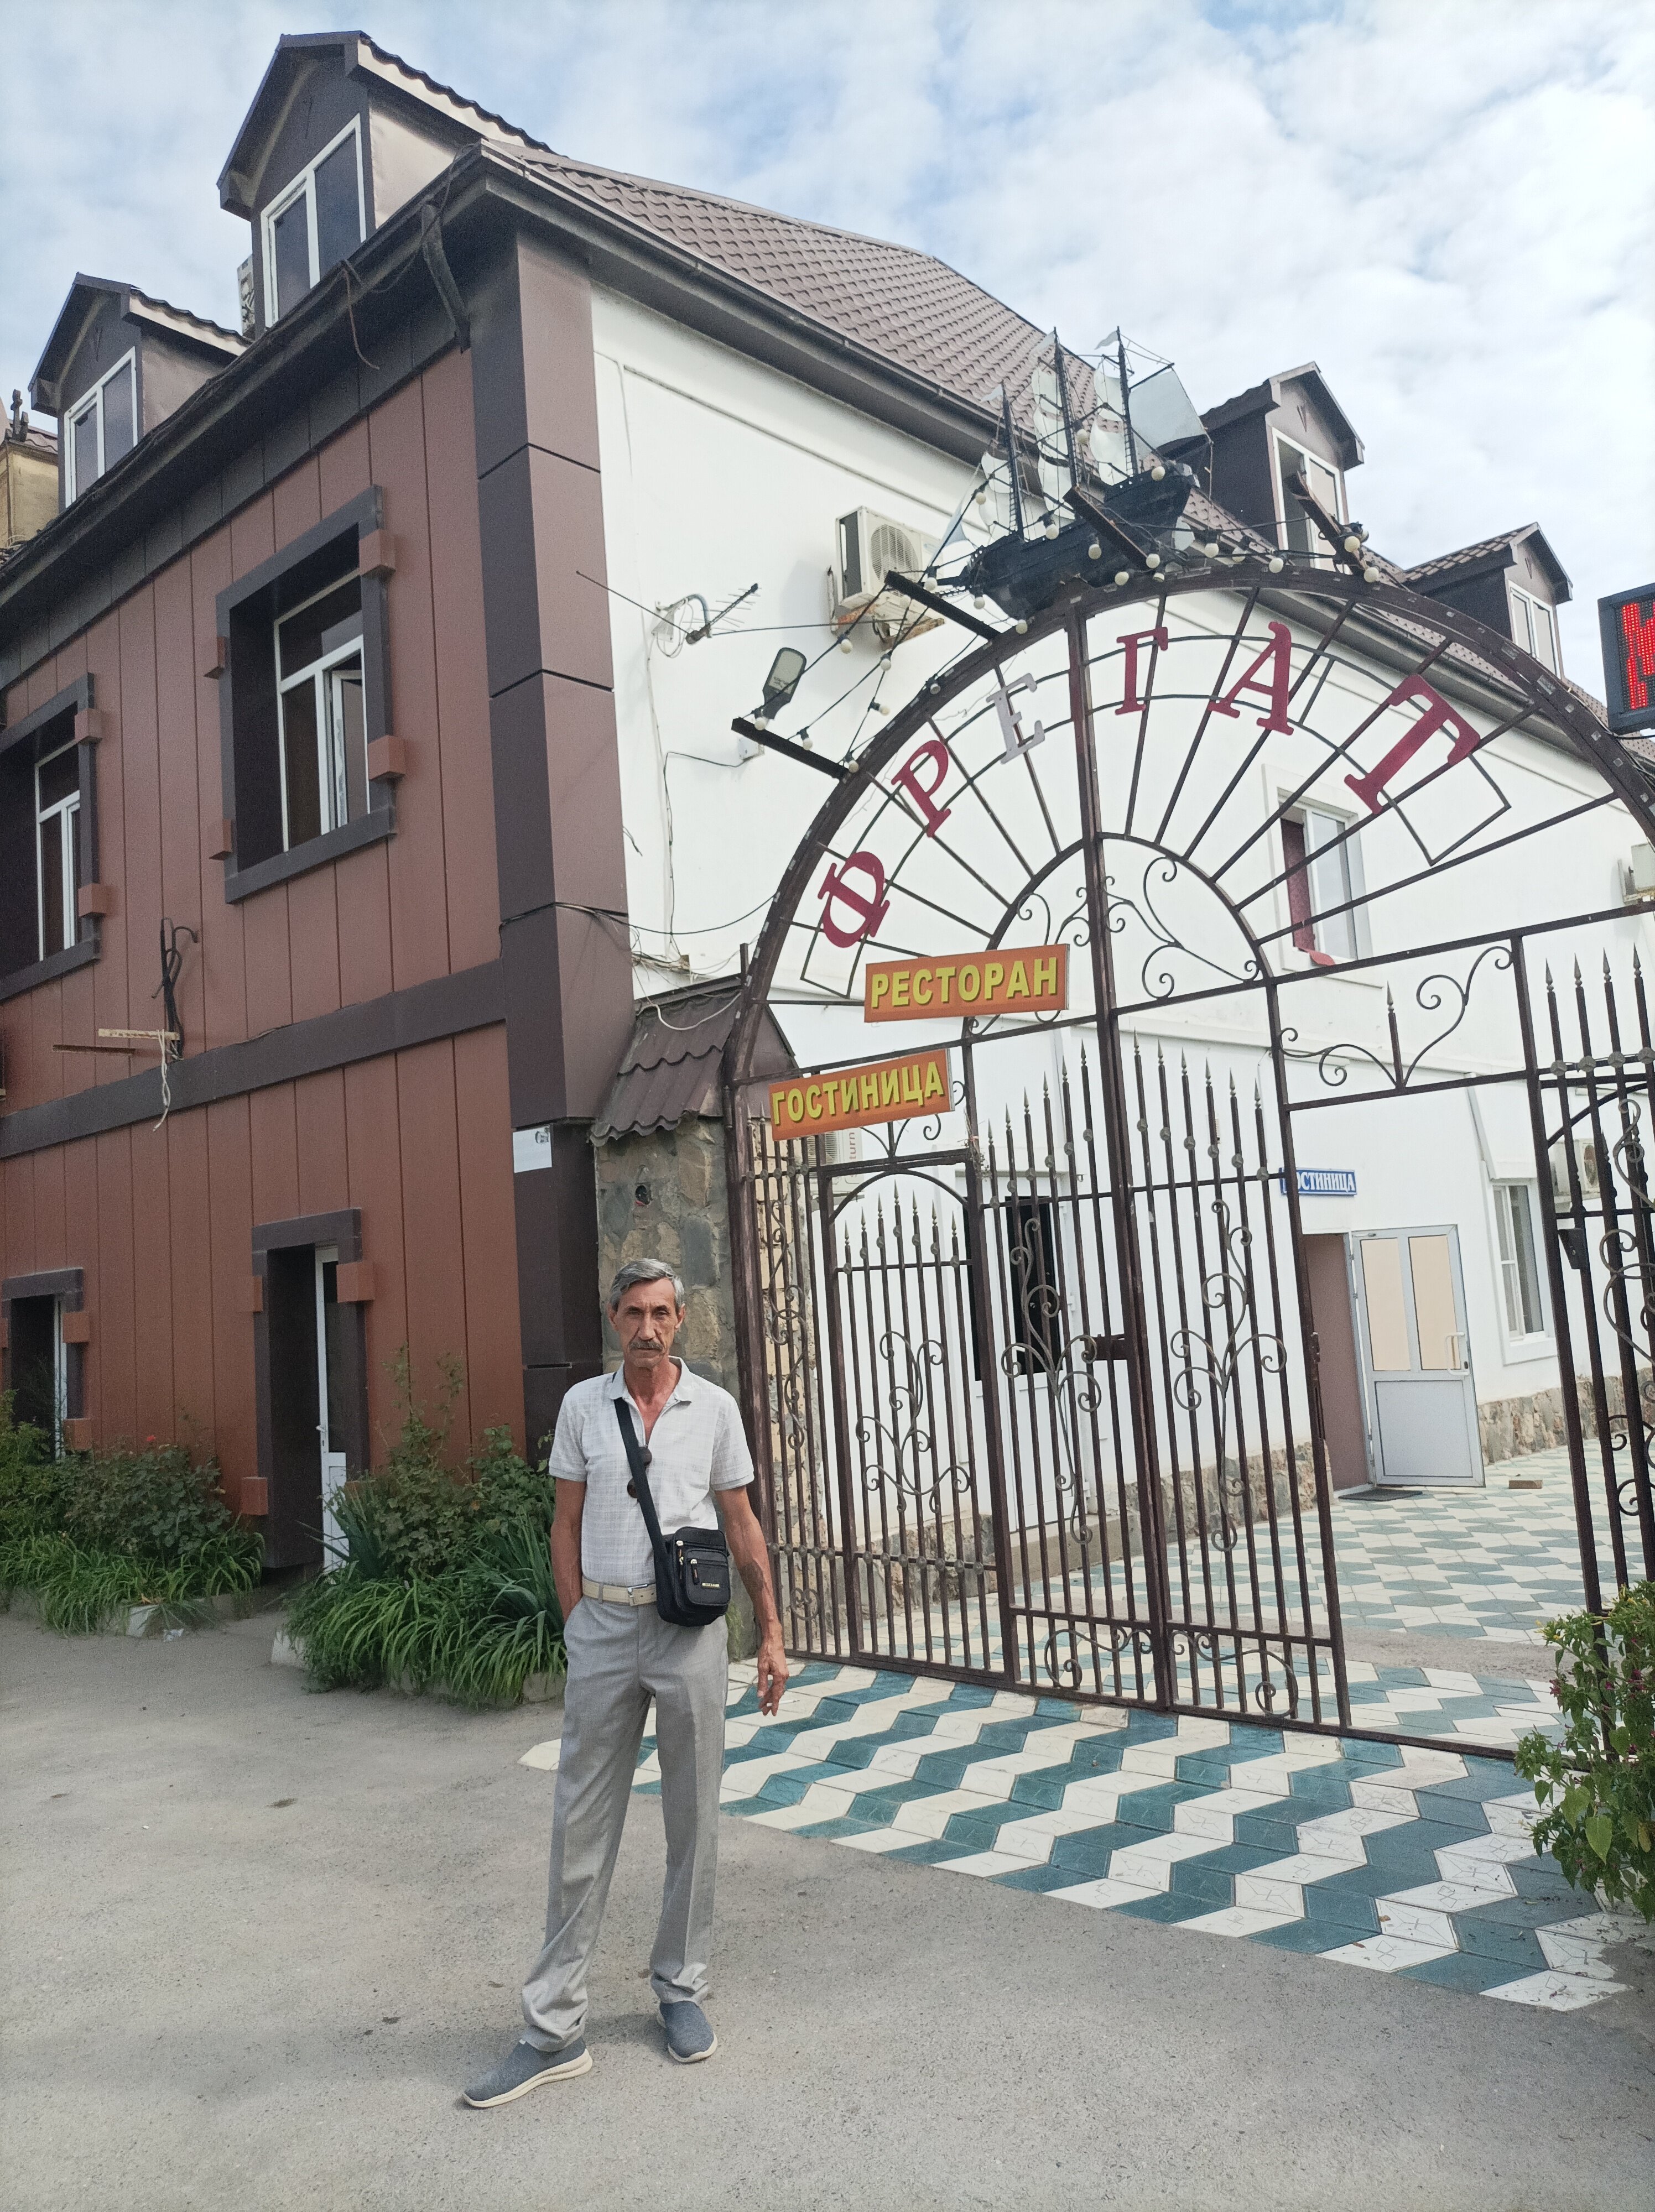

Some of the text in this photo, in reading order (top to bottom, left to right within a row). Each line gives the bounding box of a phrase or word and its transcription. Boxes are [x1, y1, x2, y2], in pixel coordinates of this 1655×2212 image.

[816, 621, 1481, 948] ФРЕГАТ
[870, 956, 1059, 1009] РЕСТОРАН
[772, 1060, 945, 1125] ГОСТИНИЦА
